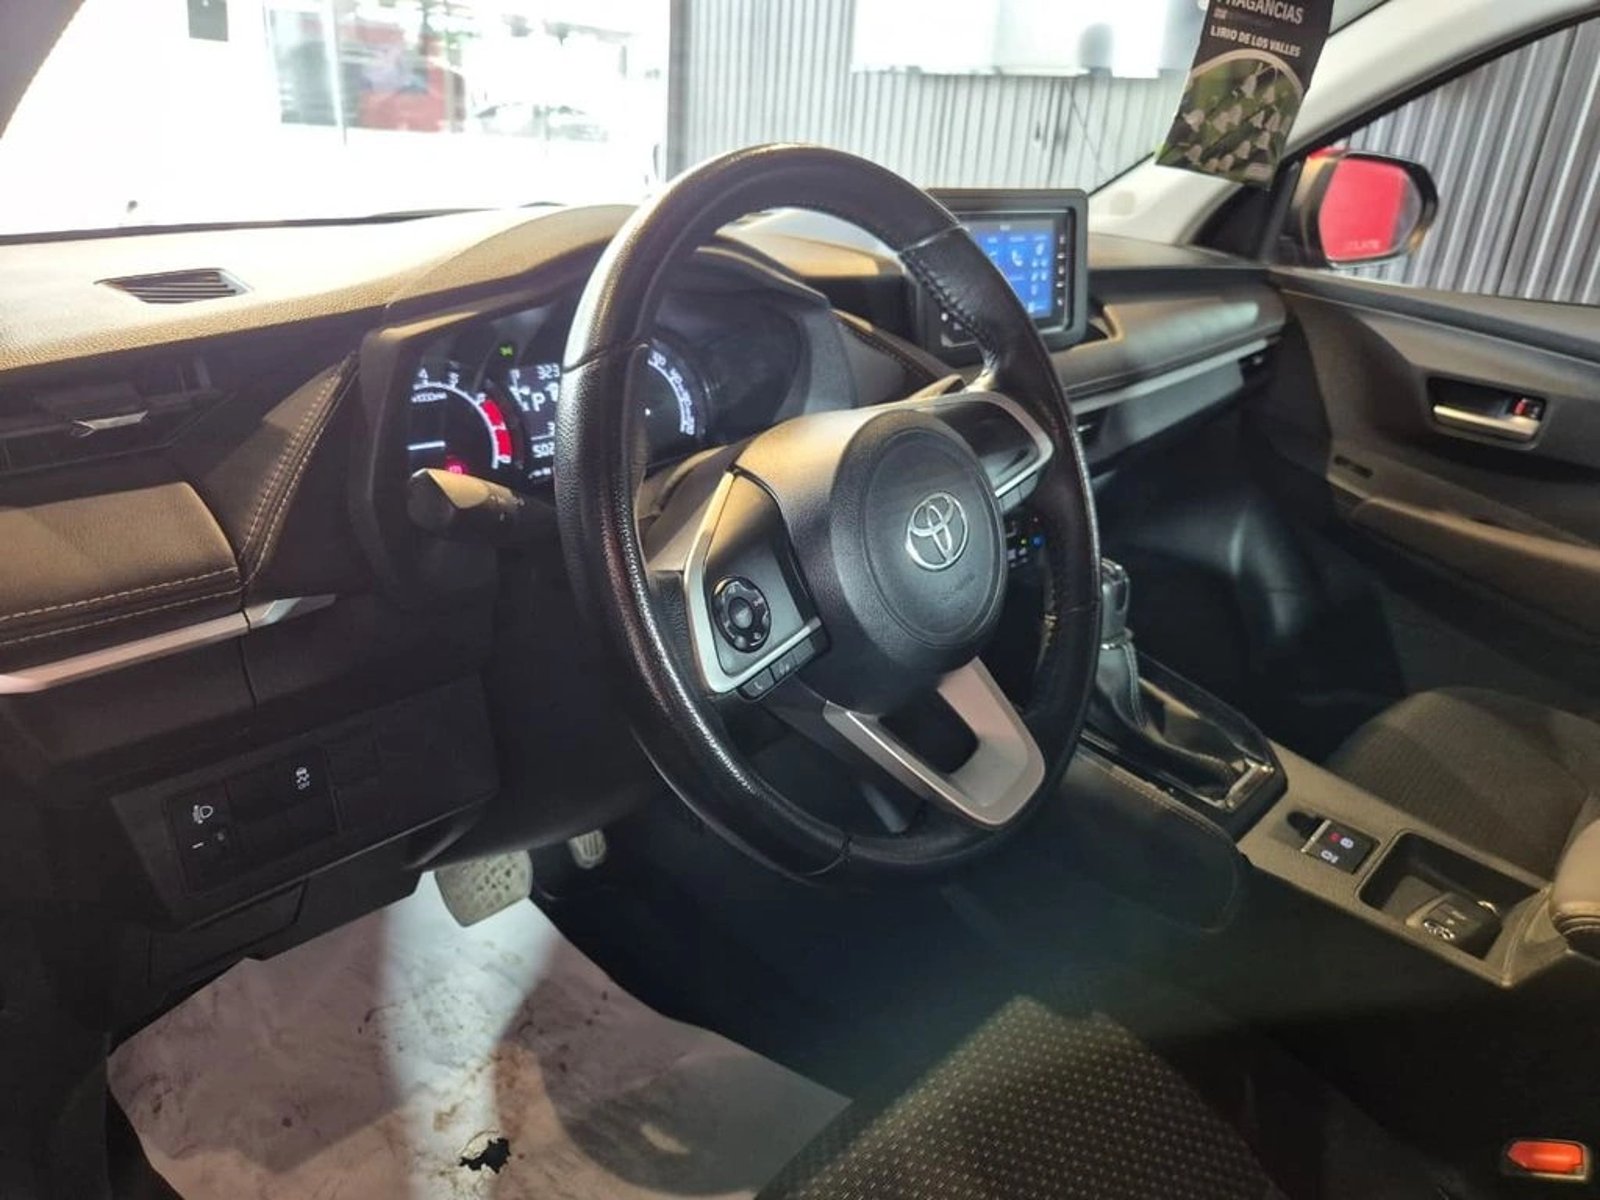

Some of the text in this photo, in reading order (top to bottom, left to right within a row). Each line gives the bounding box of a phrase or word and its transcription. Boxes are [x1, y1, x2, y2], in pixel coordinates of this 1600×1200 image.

[1217, 0, 1304, 24] AGANCIAS
[1210, 25, 1300, 57] LIRIO DE LOS VALLES
